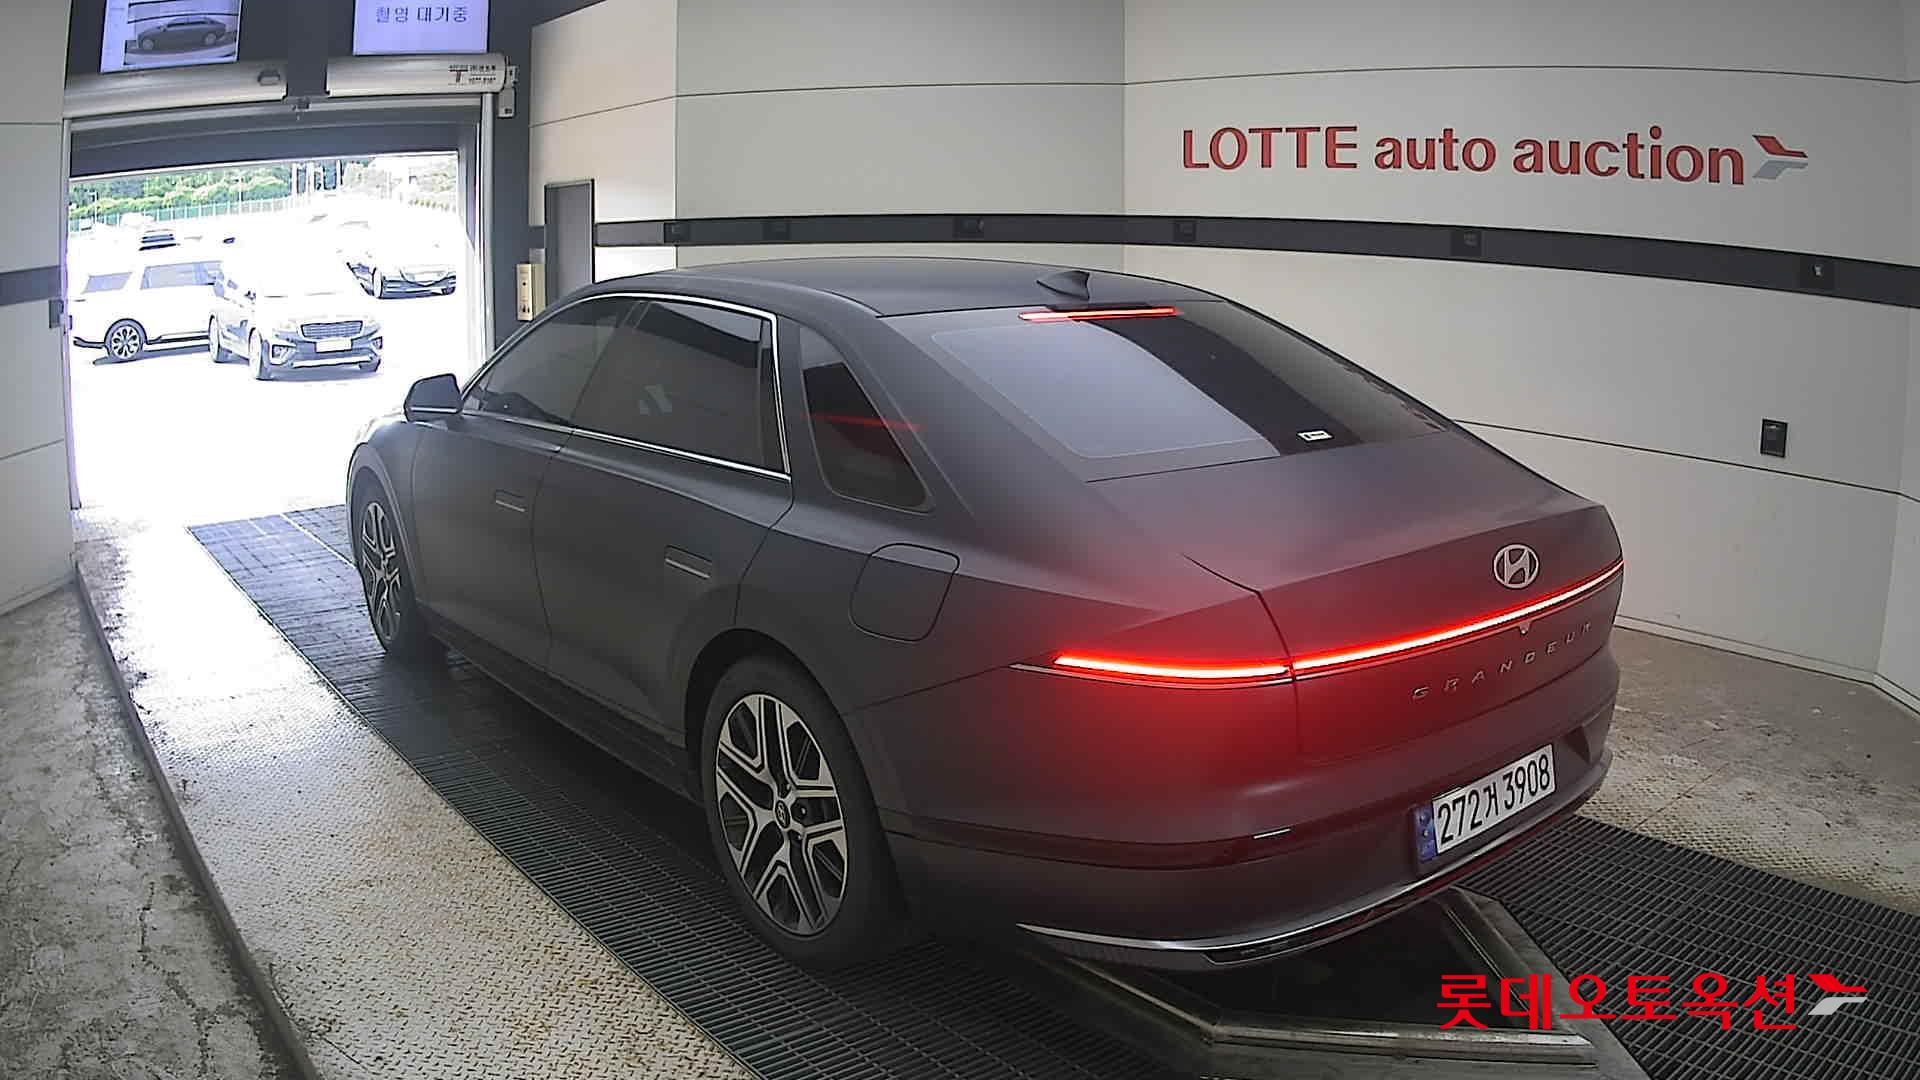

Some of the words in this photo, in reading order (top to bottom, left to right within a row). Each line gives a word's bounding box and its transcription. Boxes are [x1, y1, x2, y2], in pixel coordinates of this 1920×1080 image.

[417, 7, 467, 23] 대기중
[1183, 125, 1358, 169] LOTTE
[1374, 127, 1497, 172] auto
[1512, 125, 1745, 186] auction
[1411, 622, 1592, 700] GRANDEUR
[1437, 781, 1499, 845] 272거
[1503, 753, 1551, 811] 3908
